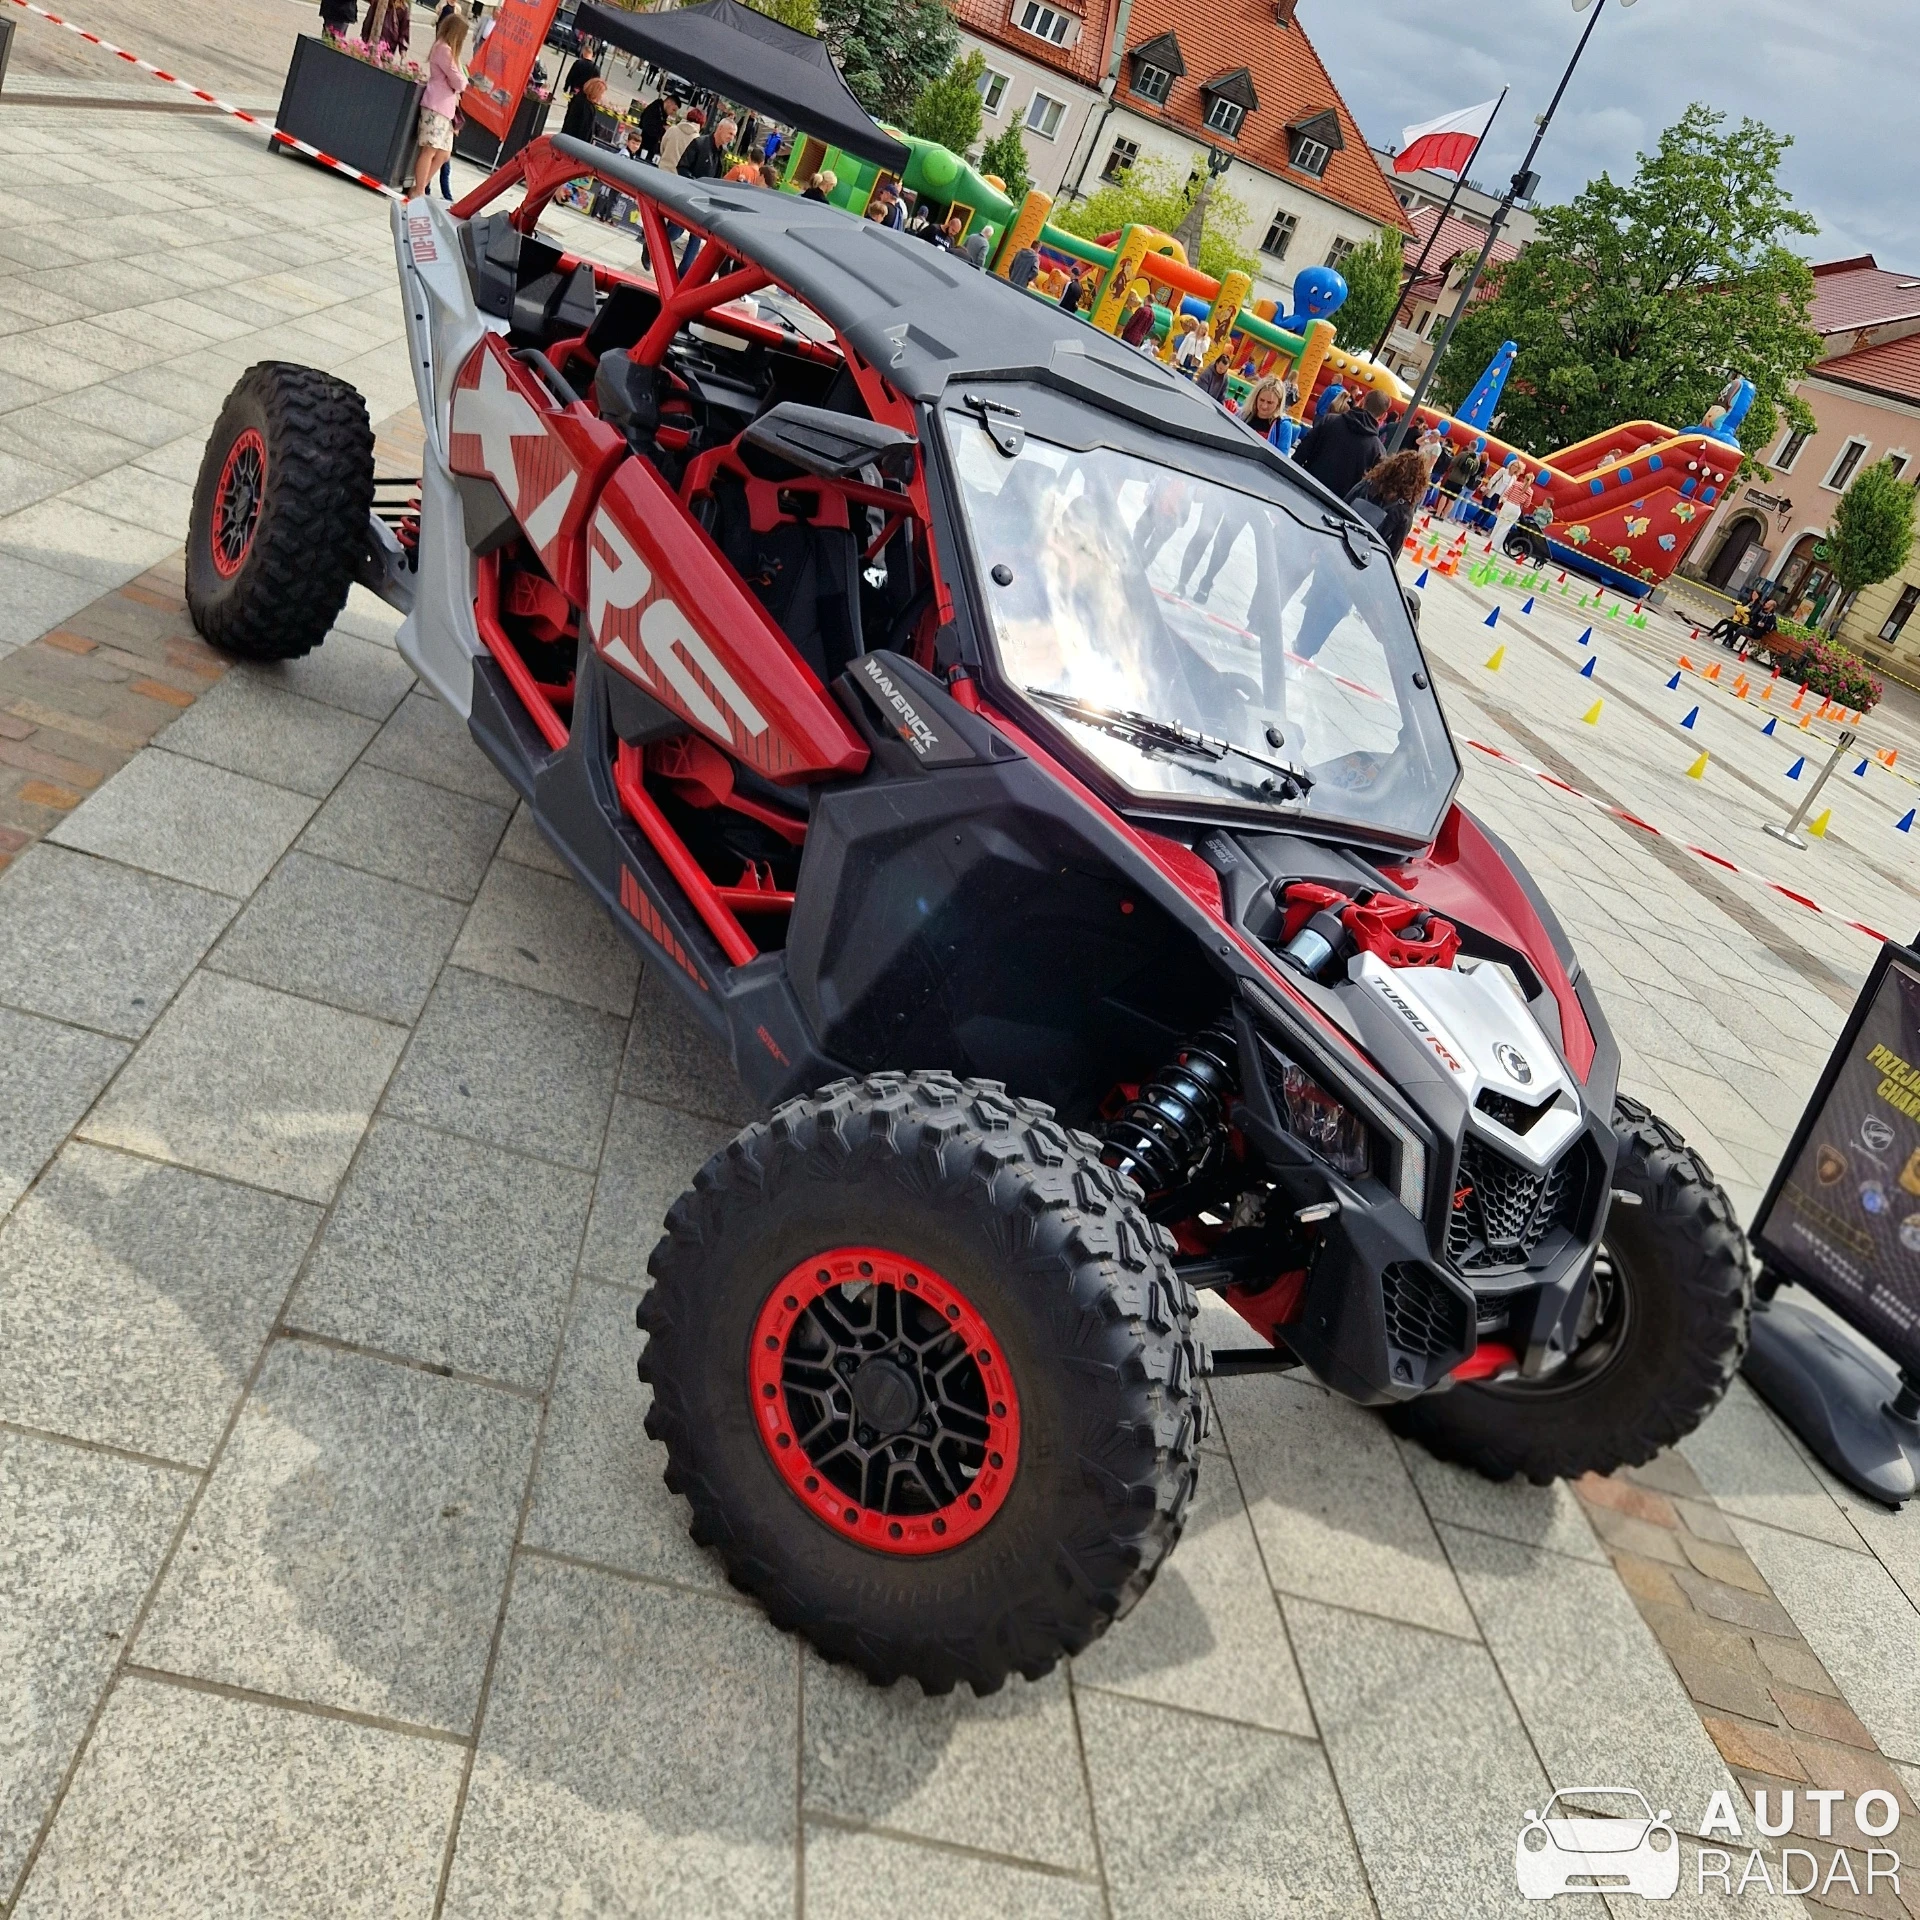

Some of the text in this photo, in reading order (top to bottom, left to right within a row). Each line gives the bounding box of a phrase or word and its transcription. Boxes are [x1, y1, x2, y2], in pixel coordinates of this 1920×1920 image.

[864, 658, 939, 749] MAVERICK
[1213, 839, 1238, 863] SMART
[1373, 977, 1461, 1072] TURBO RR
[1866, 1043, 1920, 1097] PRZEJA
[1876, 1078, 1920, 1124] CHAR
